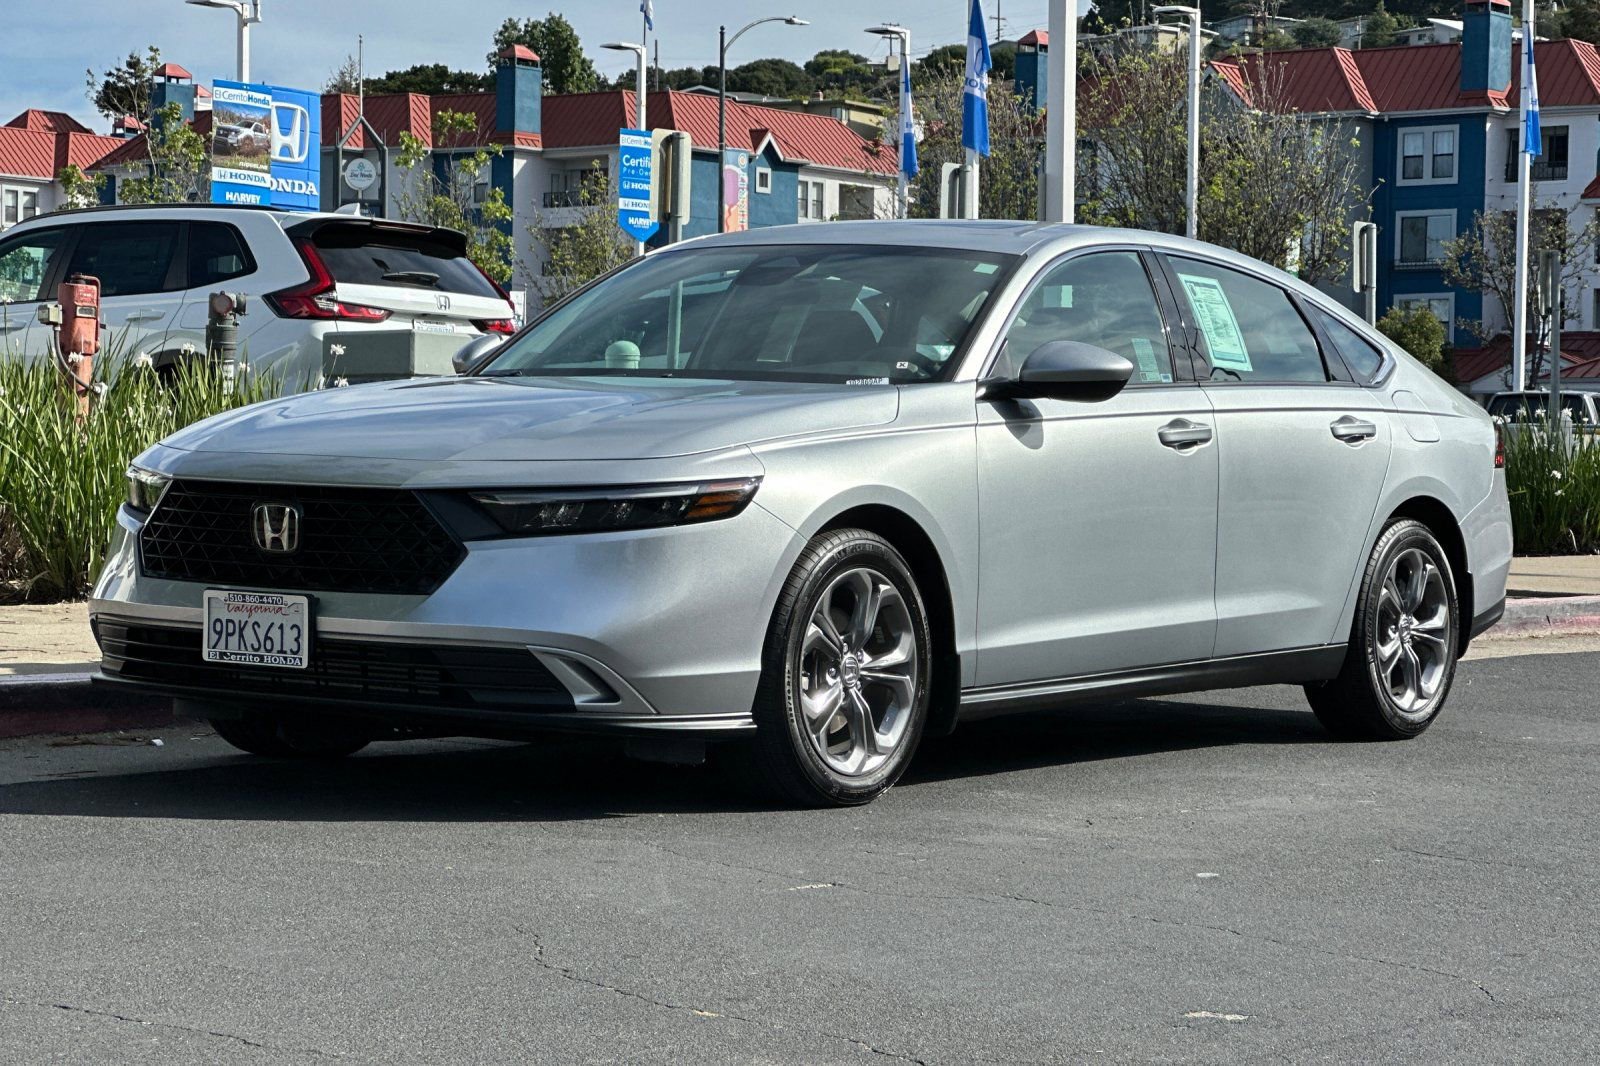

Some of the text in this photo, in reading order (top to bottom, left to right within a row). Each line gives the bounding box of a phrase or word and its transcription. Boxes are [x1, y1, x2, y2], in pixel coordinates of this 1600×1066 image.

[623, 155, 651, 168] Certifi
[229, 171, 267, 184] HONDA
[631, 182, 650, 191] HON
[225, 191, 261, 205] HARVEY
[229, 594, 282, 605] 510-860-4470
[227, 603, 290, 618] California
[212, 618, 302, 655] 9PKS613
[209, 651, 220, 660] El
[263, 655, 302, 666] HONDA
